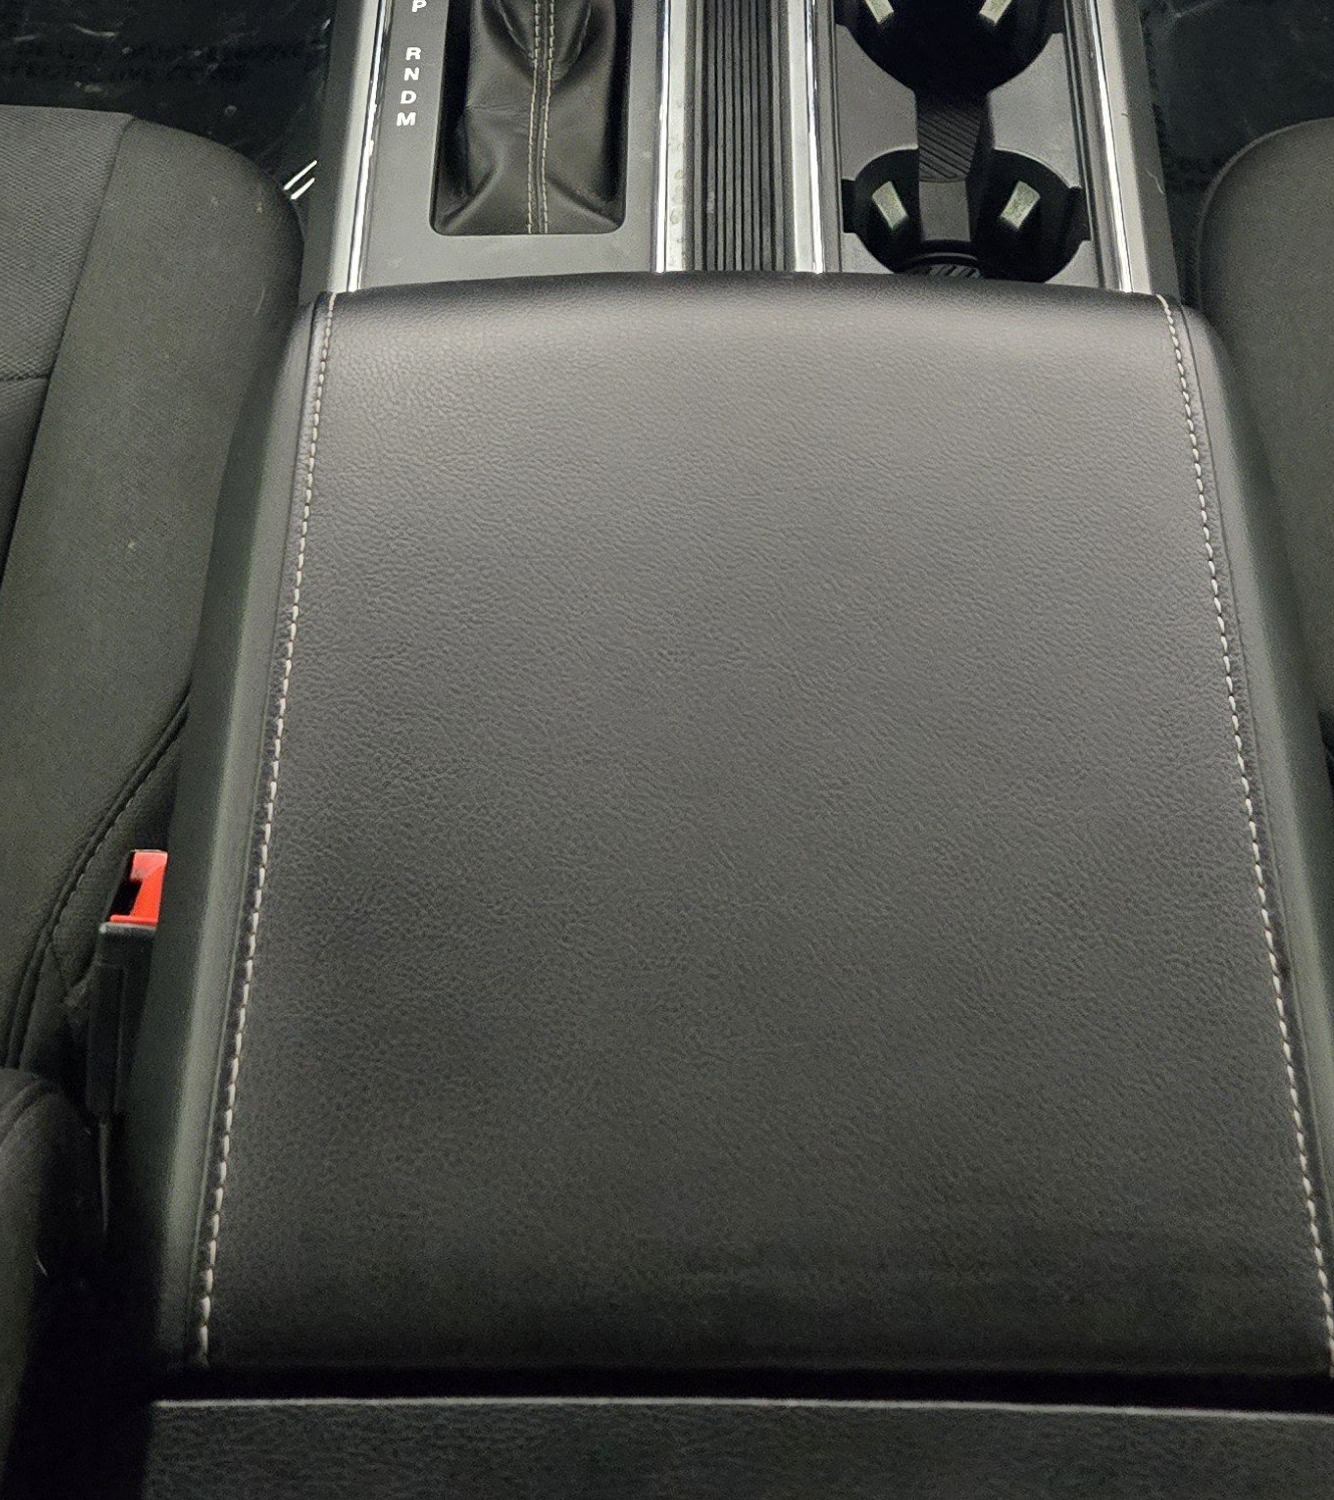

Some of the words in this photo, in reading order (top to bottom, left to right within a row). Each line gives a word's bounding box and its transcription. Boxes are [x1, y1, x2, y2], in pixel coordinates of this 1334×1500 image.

[412, 0, 427, 13] P
[405, 47, 422, 61] R
[403, 67, 420, 81] N
[400, 90, 417, 104] D
[396, 112, 416, 126] M
